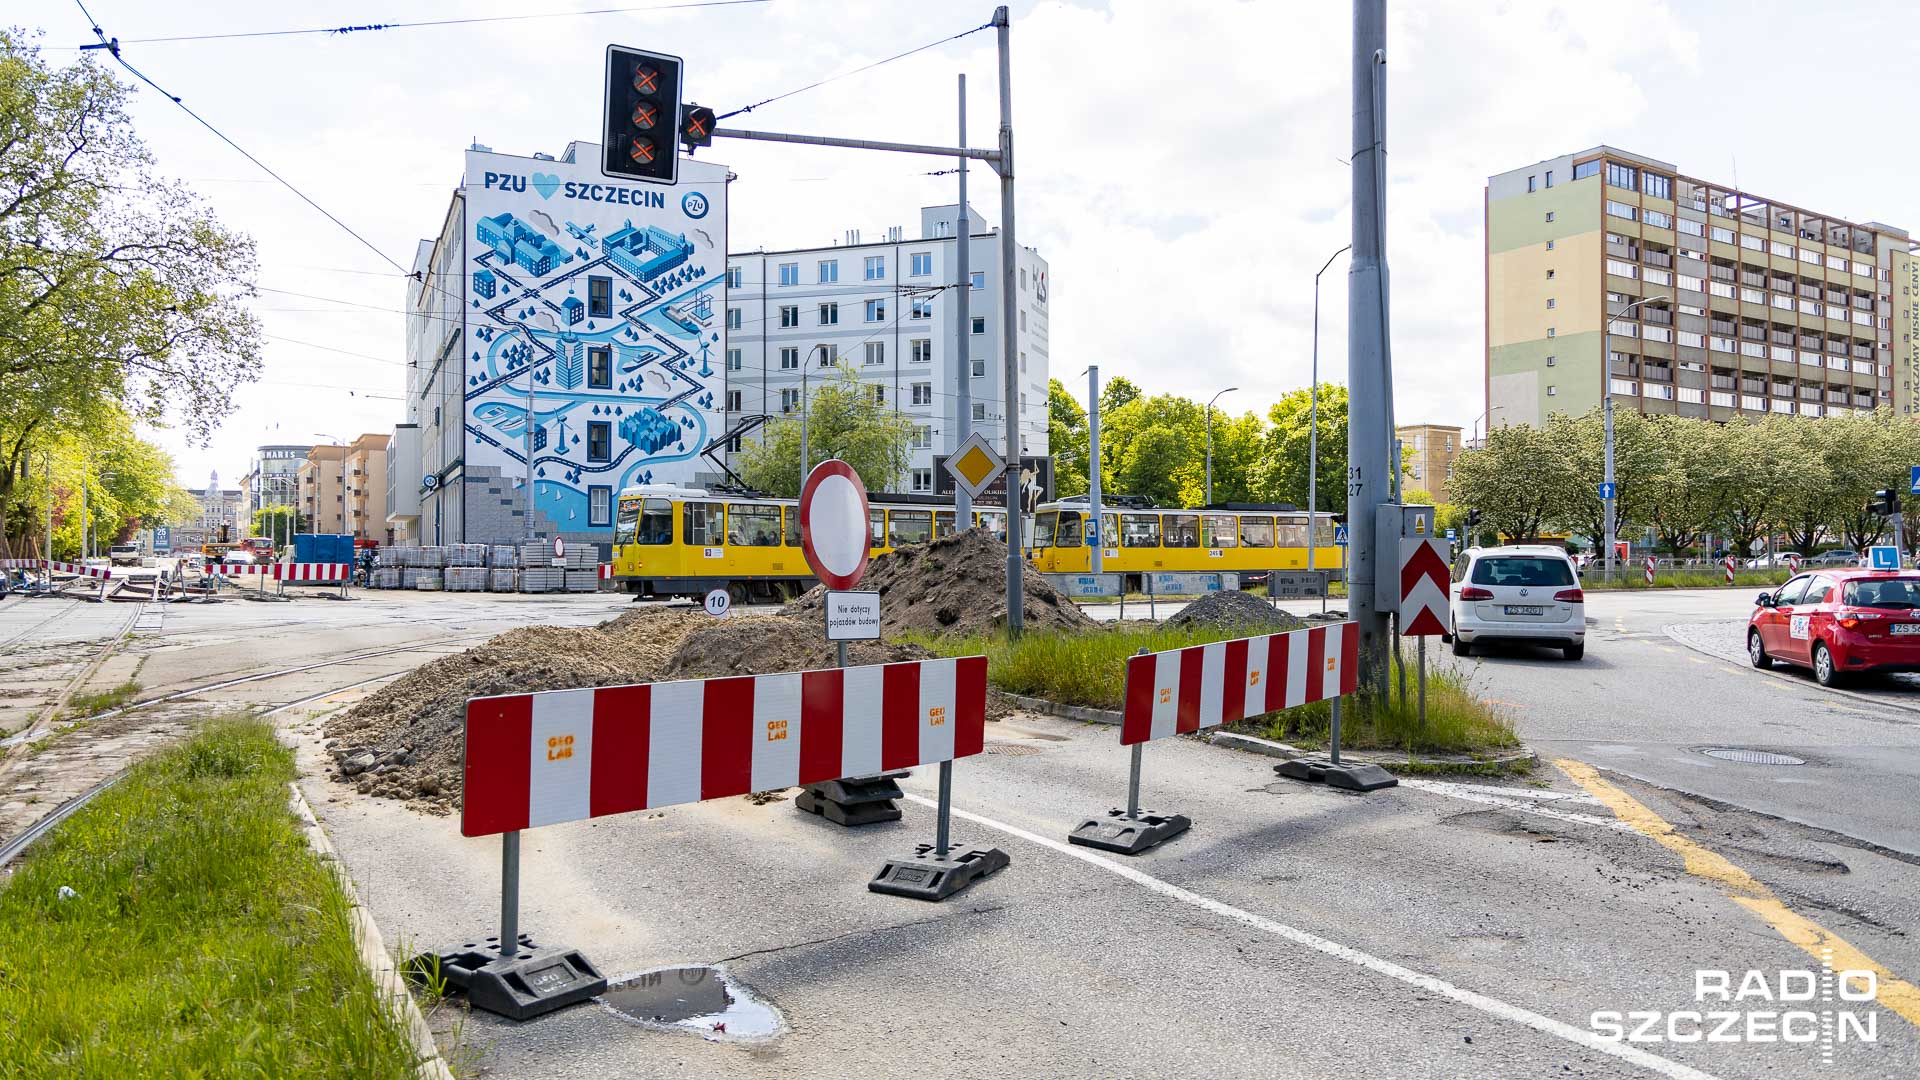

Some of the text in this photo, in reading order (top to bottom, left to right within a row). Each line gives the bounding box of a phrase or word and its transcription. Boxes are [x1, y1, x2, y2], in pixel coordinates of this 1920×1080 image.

[484, 171, 665, 209] PZU SZCZECIN
[688, 199, 704, 211] PZU
[1912, 301, 1920, 340] NISKIE
[1349, 466, 1361, 480] 31
[1349, 483, 1363, 497] 27
[1879, 551, 1891, 565] L
[710, 596, 725, 608] 10
[837, 604, 871, 615] Nie dotyczy
[830, 616, 878, 628] pojazdów budowy
[1896, 624, 1910, 633] ZS
[767, 720, 787, 730] GEO
[547, 735, 575, 748] GEO
[767, 730, 787, 741] LAB
[547, 748, 574, 761] LAB
